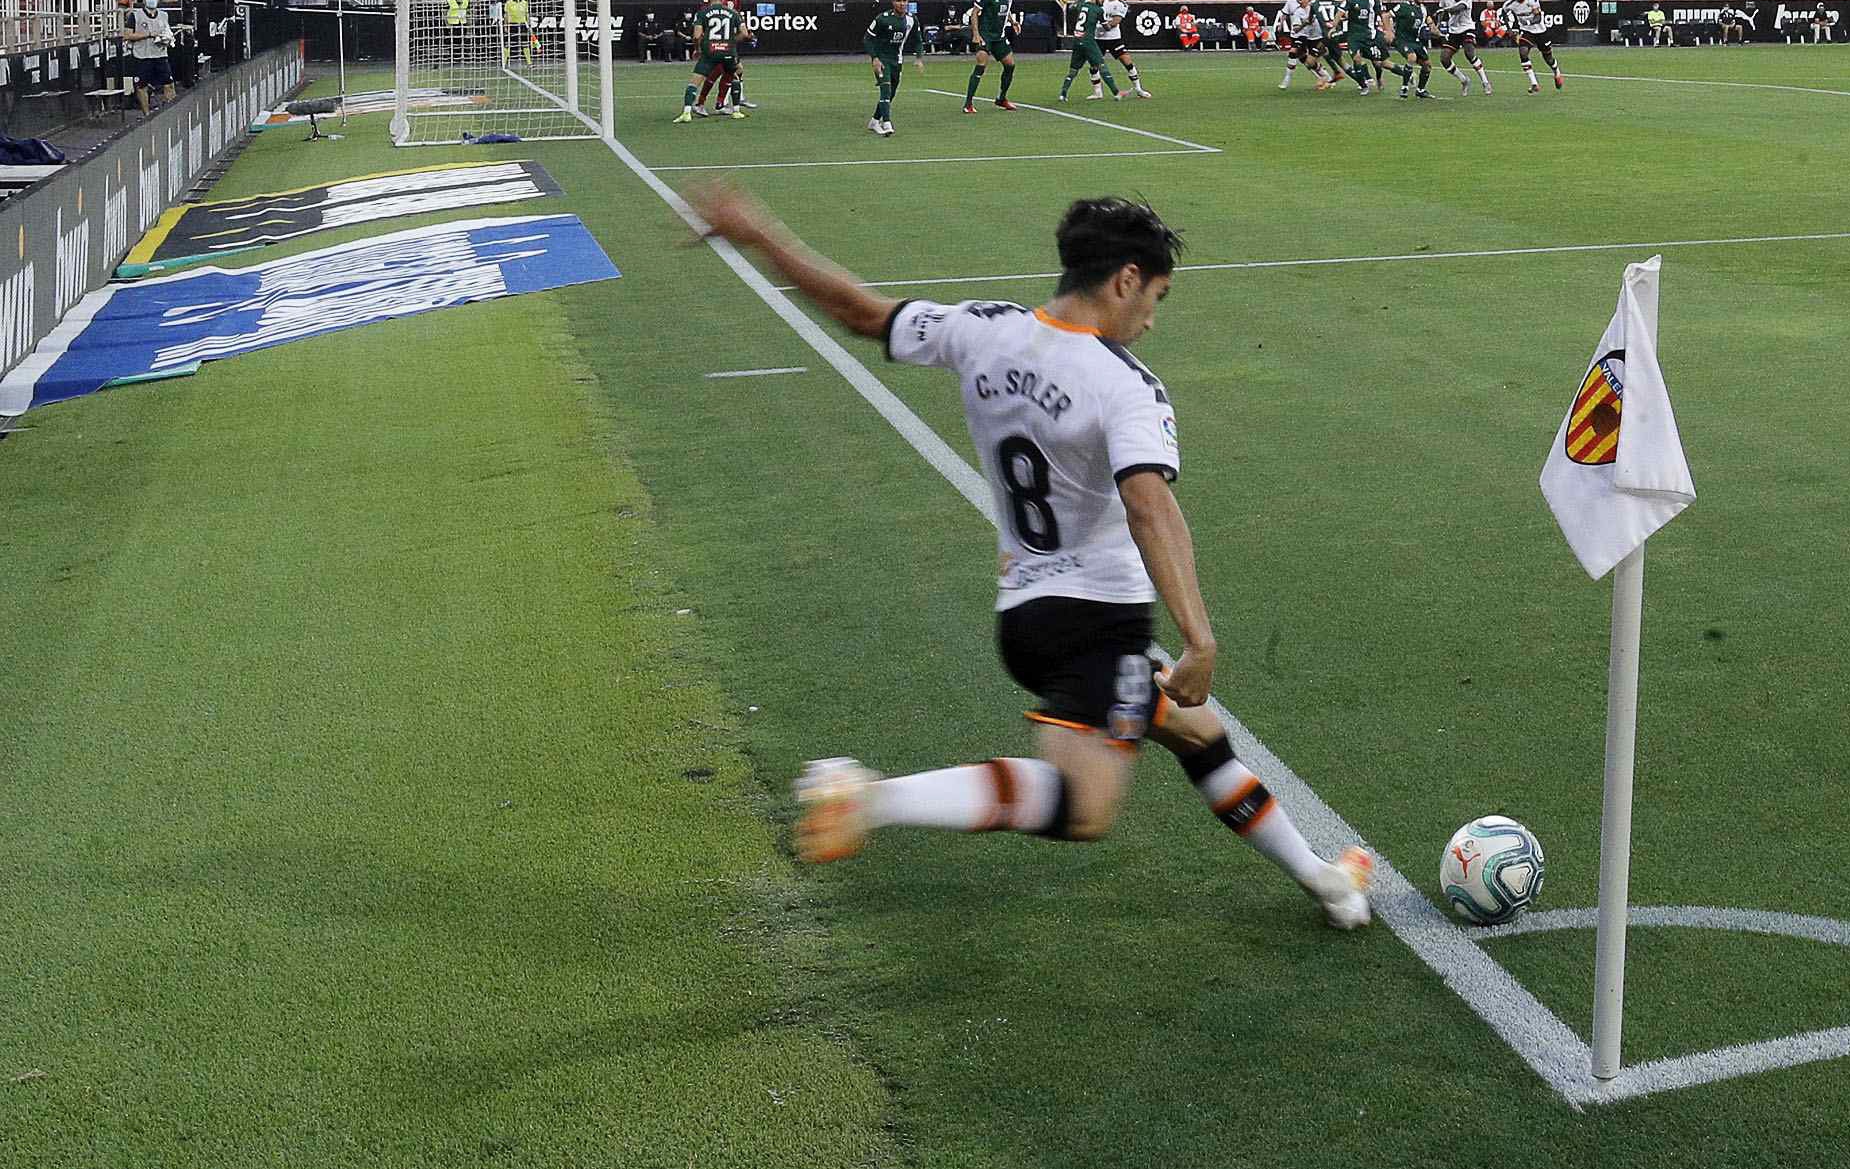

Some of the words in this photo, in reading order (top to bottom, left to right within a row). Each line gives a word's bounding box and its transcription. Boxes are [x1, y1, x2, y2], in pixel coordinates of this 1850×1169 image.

[708, 17, 730, 41] 21
[741, 11, 817, 32] ibertex
[1075, 12, 1087, 32] 2
[1318, 5, 1335, 22] 17
[103, 158, 127, 271] bwin
[139, 135, 160, 232] bwin
[55, 186, 89, 320] bwin
[0, 224, 35, 377] win
[975, 374, 999, 401] C.
[1005, 368, 1072, 422] SOLER
[996, 434, 1060, 555] 8
